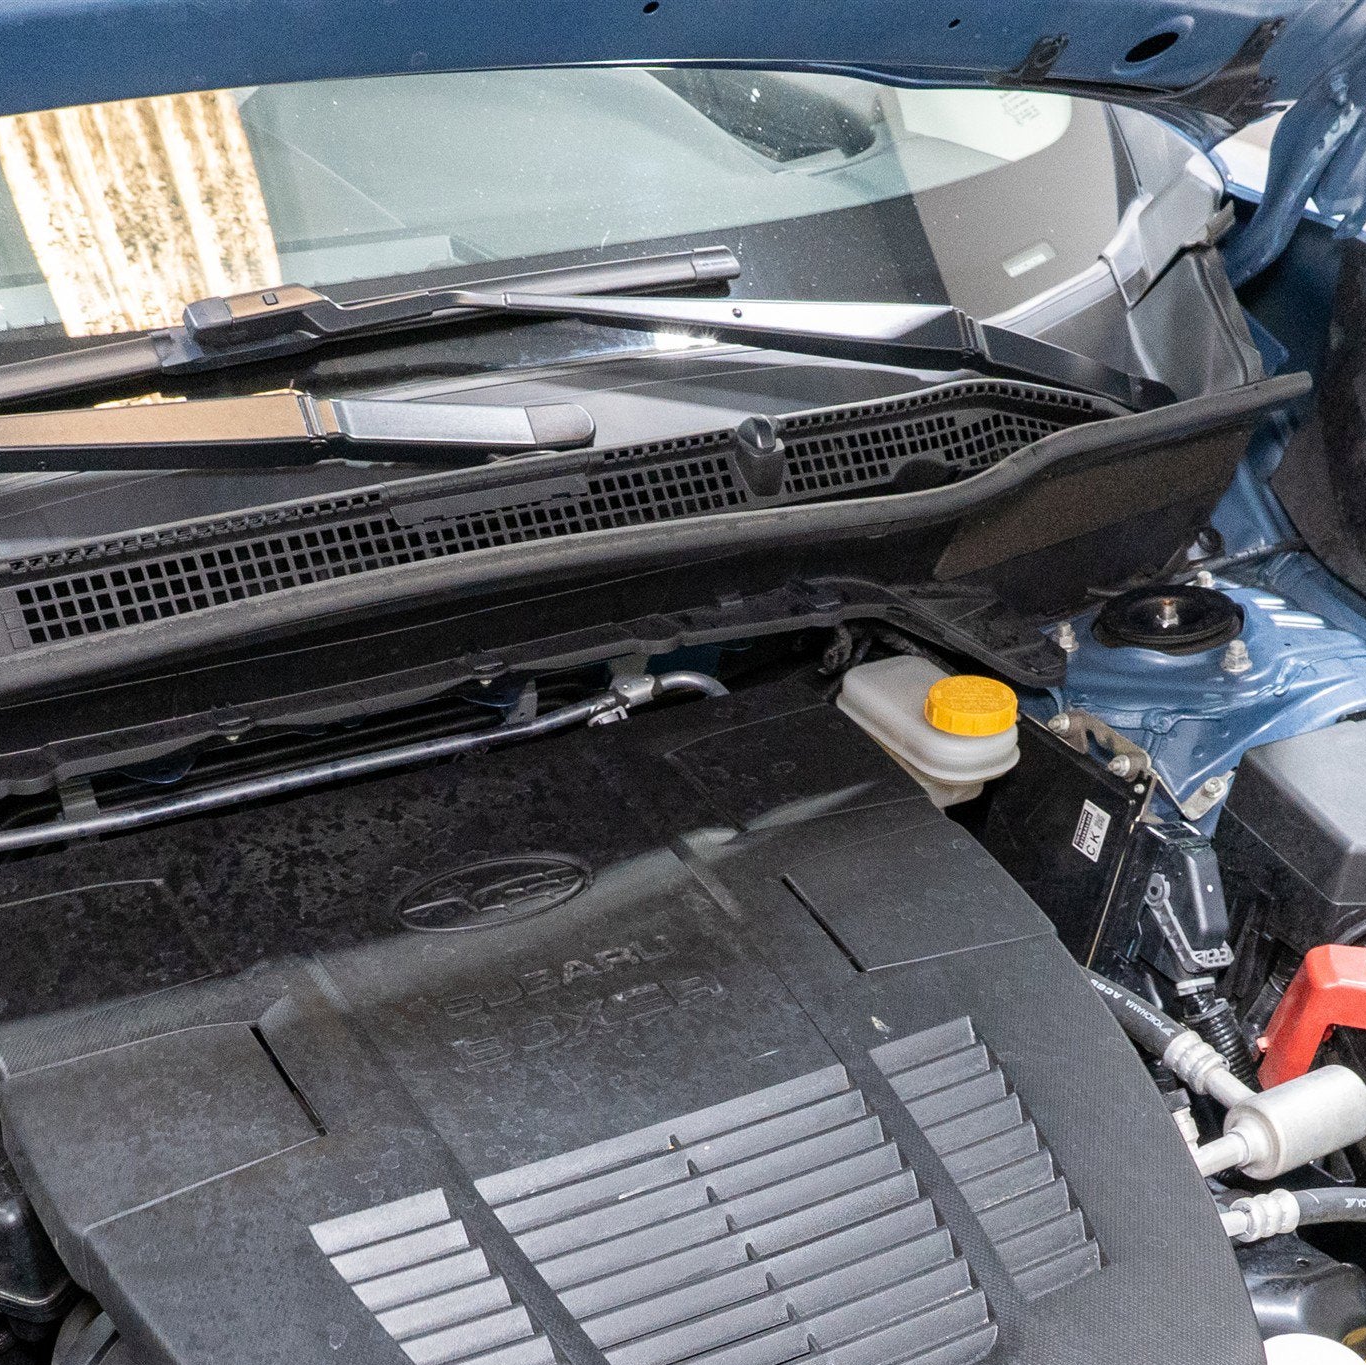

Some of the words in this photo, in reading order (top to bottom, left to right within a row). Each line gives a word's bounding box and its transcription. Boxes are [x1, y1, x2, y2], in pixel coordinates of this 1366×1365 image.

[443, 934, 676, 1020] SUBARU
[1125, 999, 1165, 1030] YOKOHAMA
[452, 972, 725, 1070] BOXER
